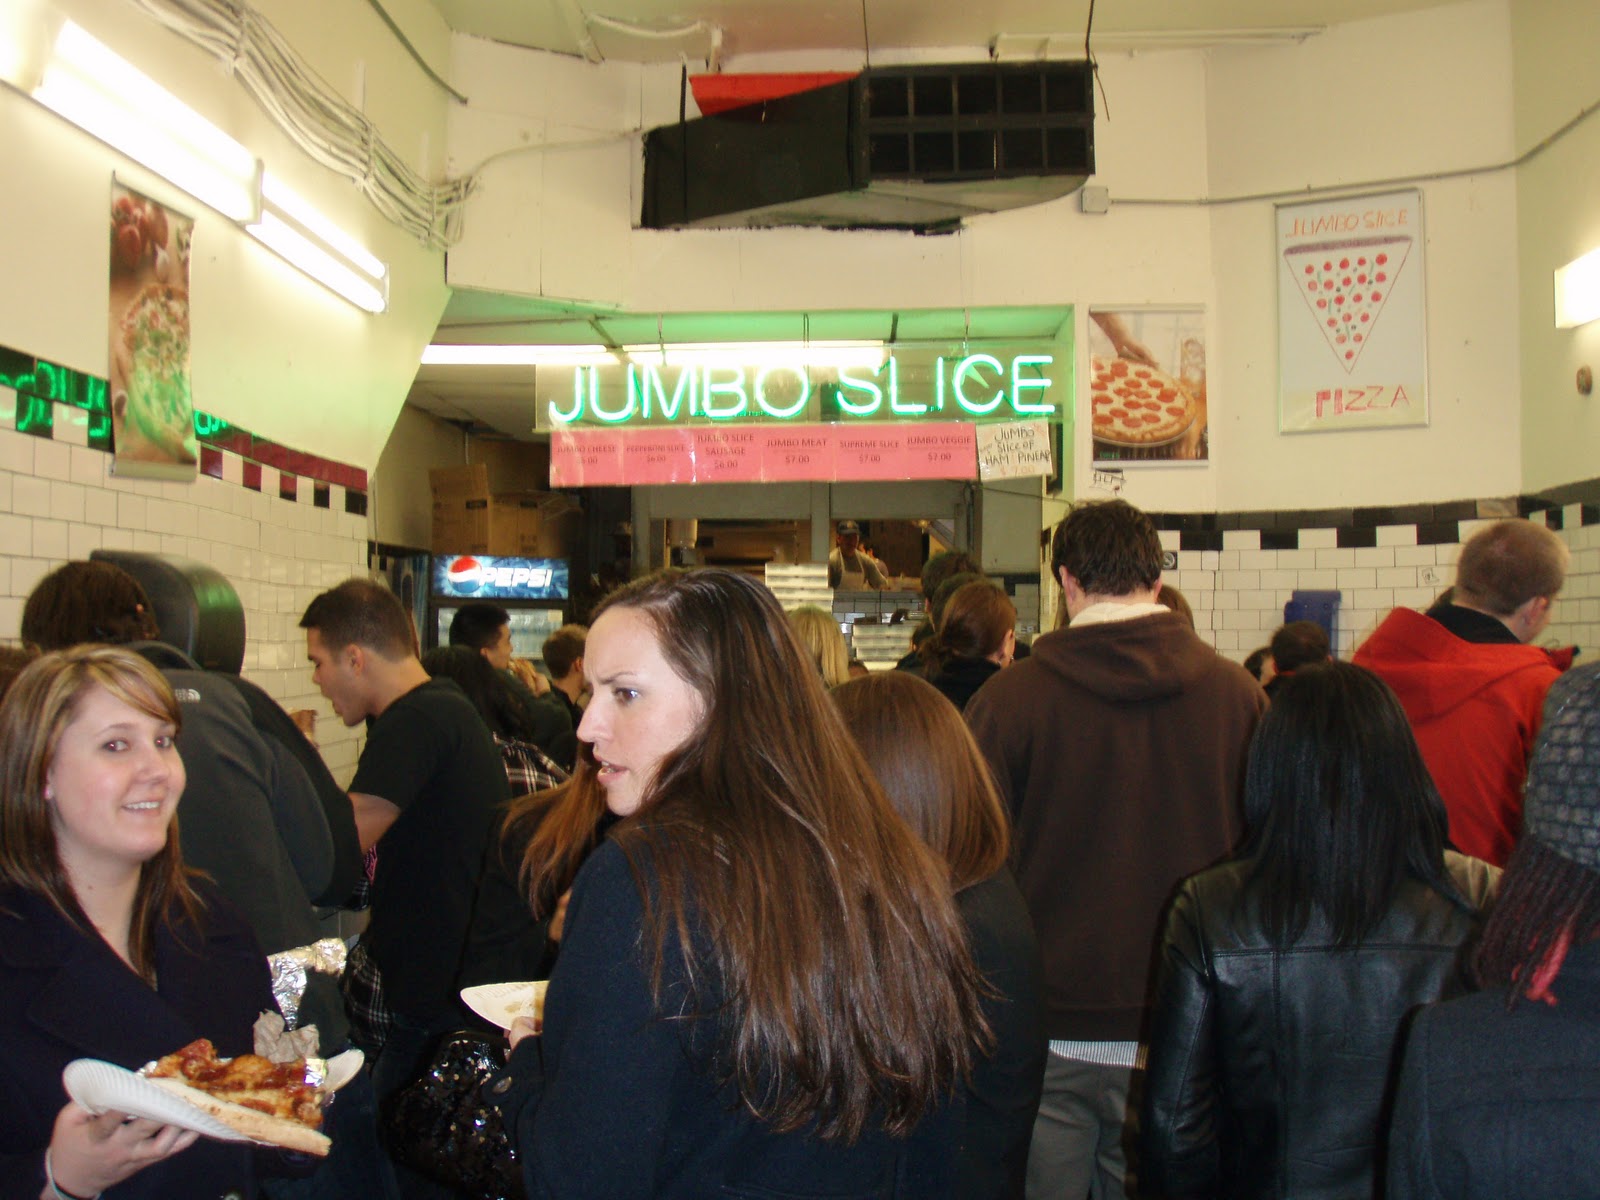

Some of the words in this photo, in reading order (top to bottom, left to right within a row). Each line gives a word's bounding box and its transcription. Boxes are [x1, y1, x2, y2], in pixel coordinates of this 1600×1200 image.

[1285, 214, 1359, 238] JUMBO
[548, 362, 811, 424] JUMBO
[836, 354, 1056, 416] SLICE
[1315, 384, 1410, 418] PIZZA
[697, 433, 729, 443] JUMBO
[731, 432, 755, 441] SLICE
[767, 439, 799, 447] JUMBO
[801, 438, 827, 447] MEAT
[907, 435, 937, 445] JUMBO
[940, 435, 971, 444] VEGGIE
[840, 441, 877, 449] SUPREME
[880, 440, 899, 449] SLICE
[705, 447, 746, 456] SAUSAGE
[927, 451, 951, 461] $7.00
[785, 455, 810, 464] $7.00
[985, 454, 1010, 466] HAM
[478, 567, 553, 588] PEPSI
